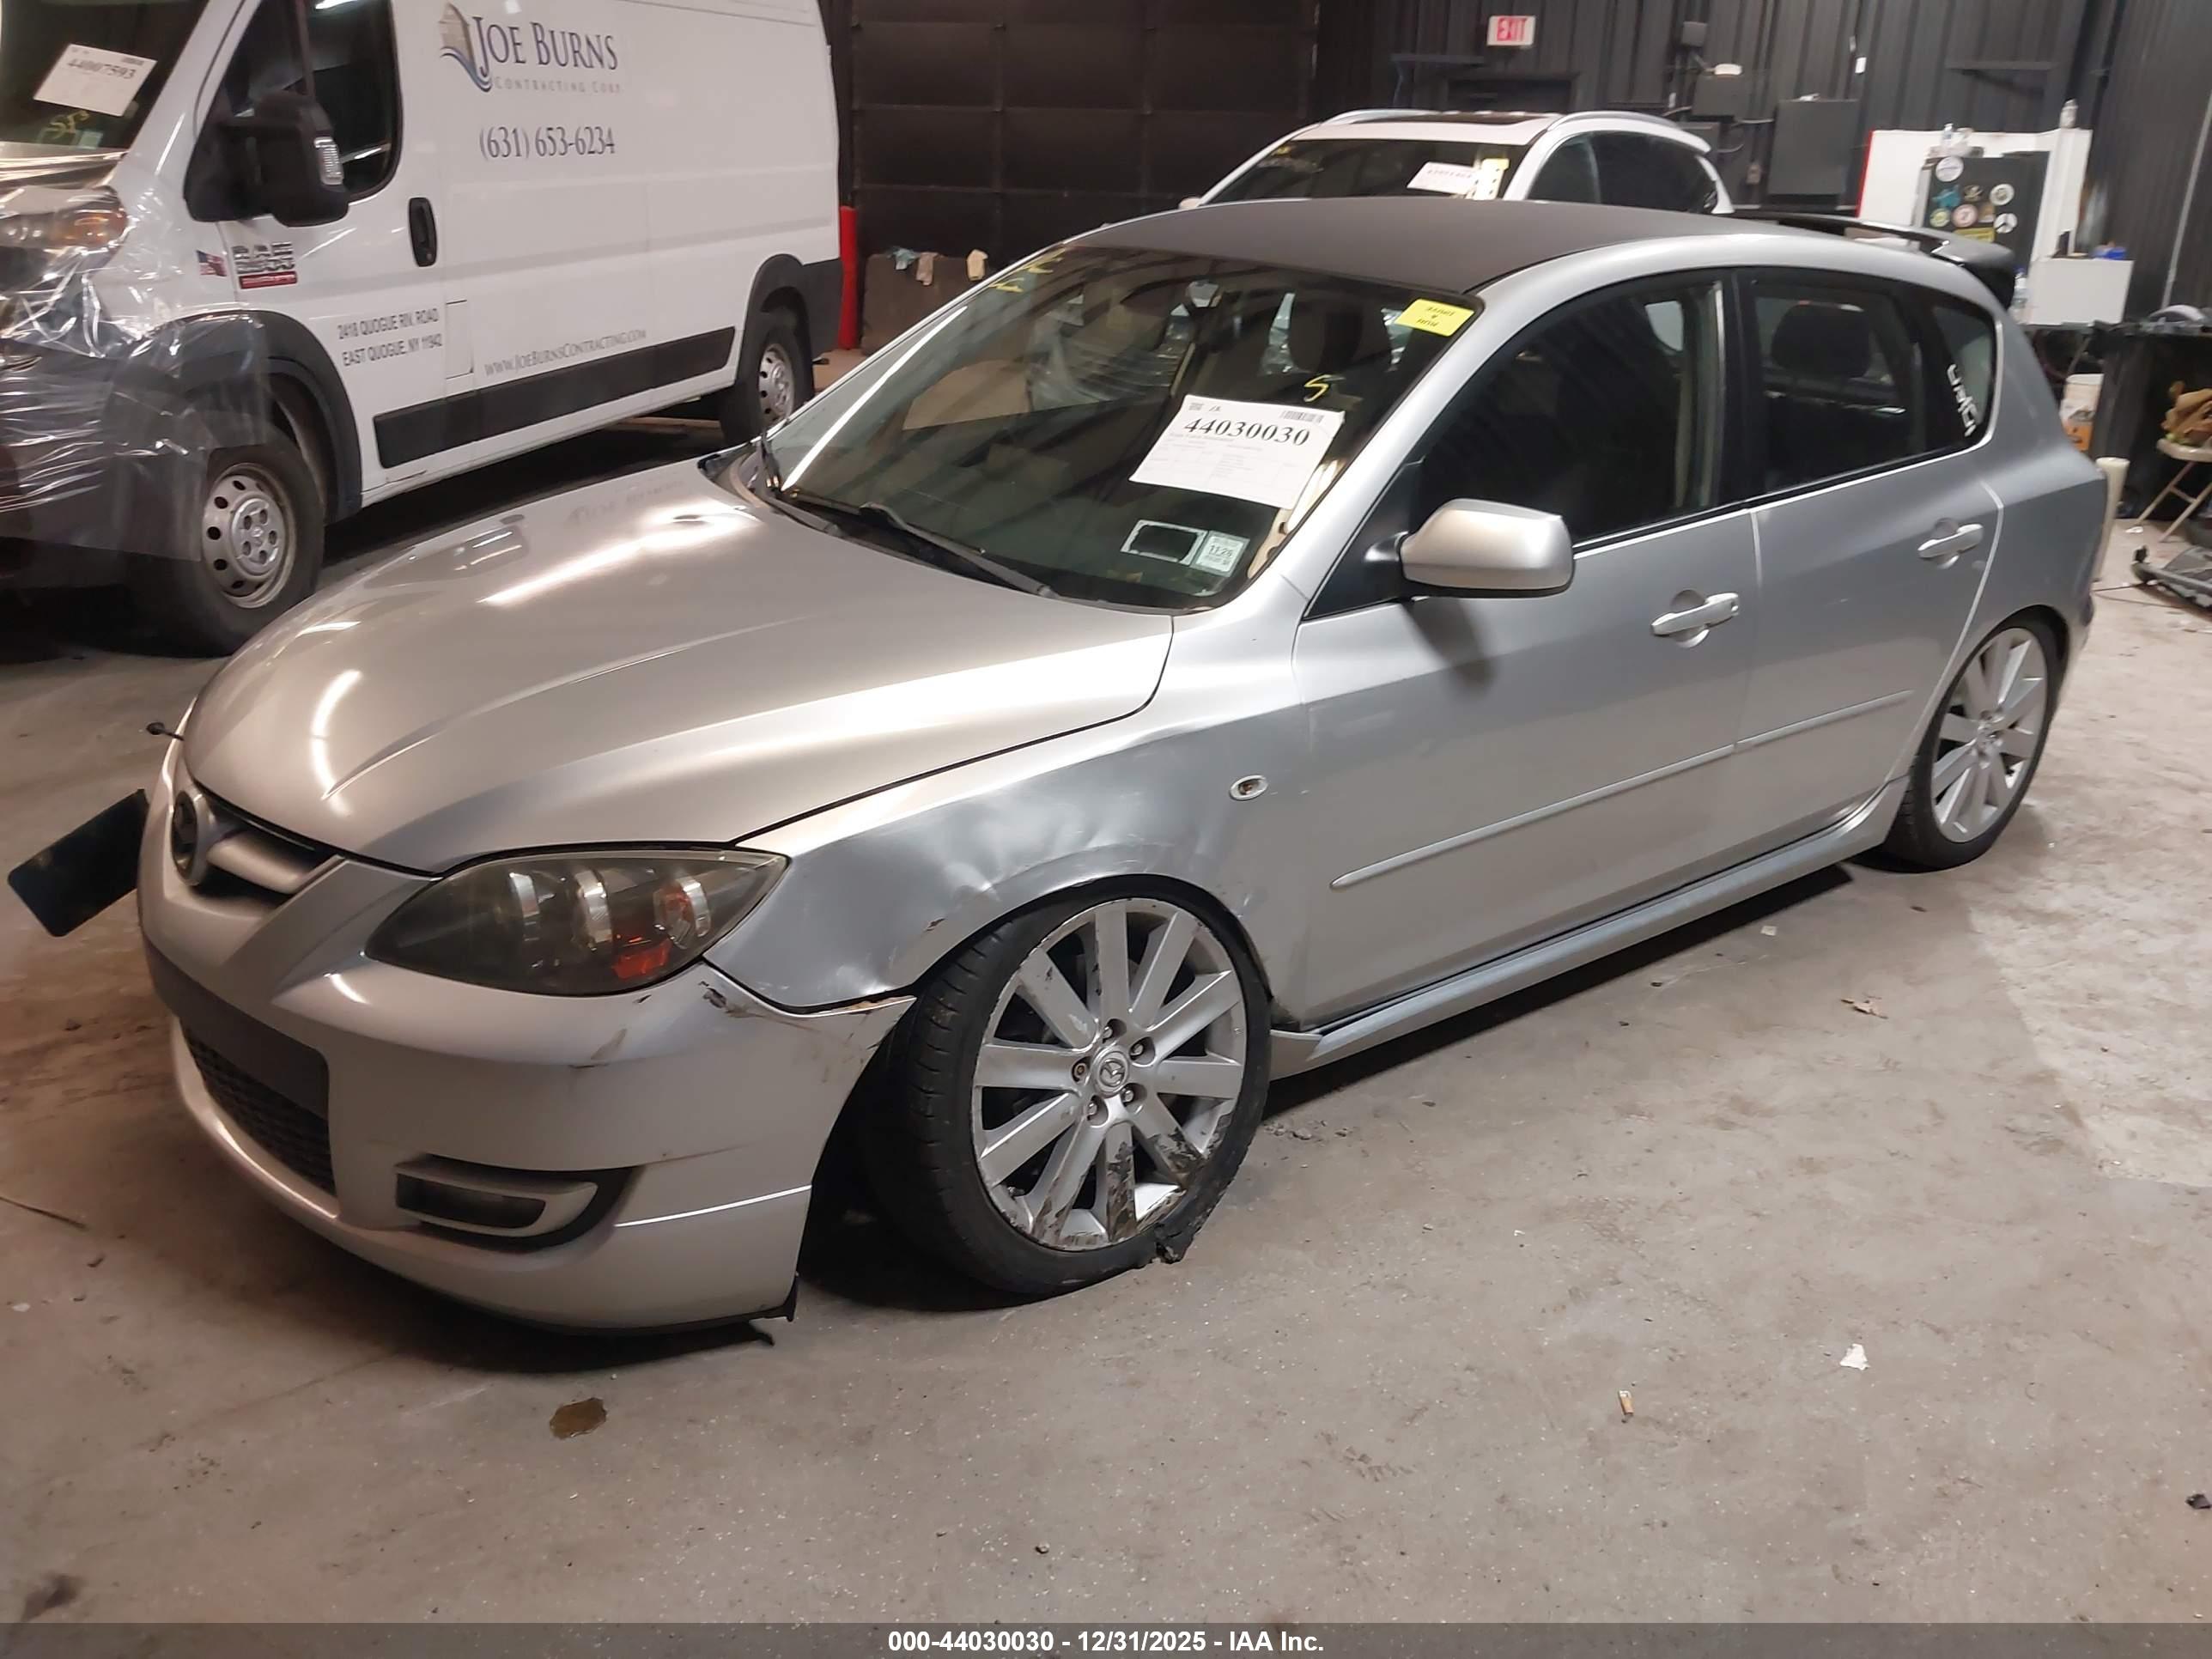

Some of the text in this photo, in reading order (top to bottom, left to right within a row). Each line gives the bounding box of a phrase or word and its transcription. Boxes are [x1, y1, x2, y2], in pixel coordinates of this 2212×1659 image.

[1497, 17, 1527, 41] EXIT
[472, 16, 617, 77] JOE BURNS
[479, 126, 616, 161] (631) 653-6234
[342, 348, 366, 367] EAST
[1184, 417, 1310, 447] 44030030
